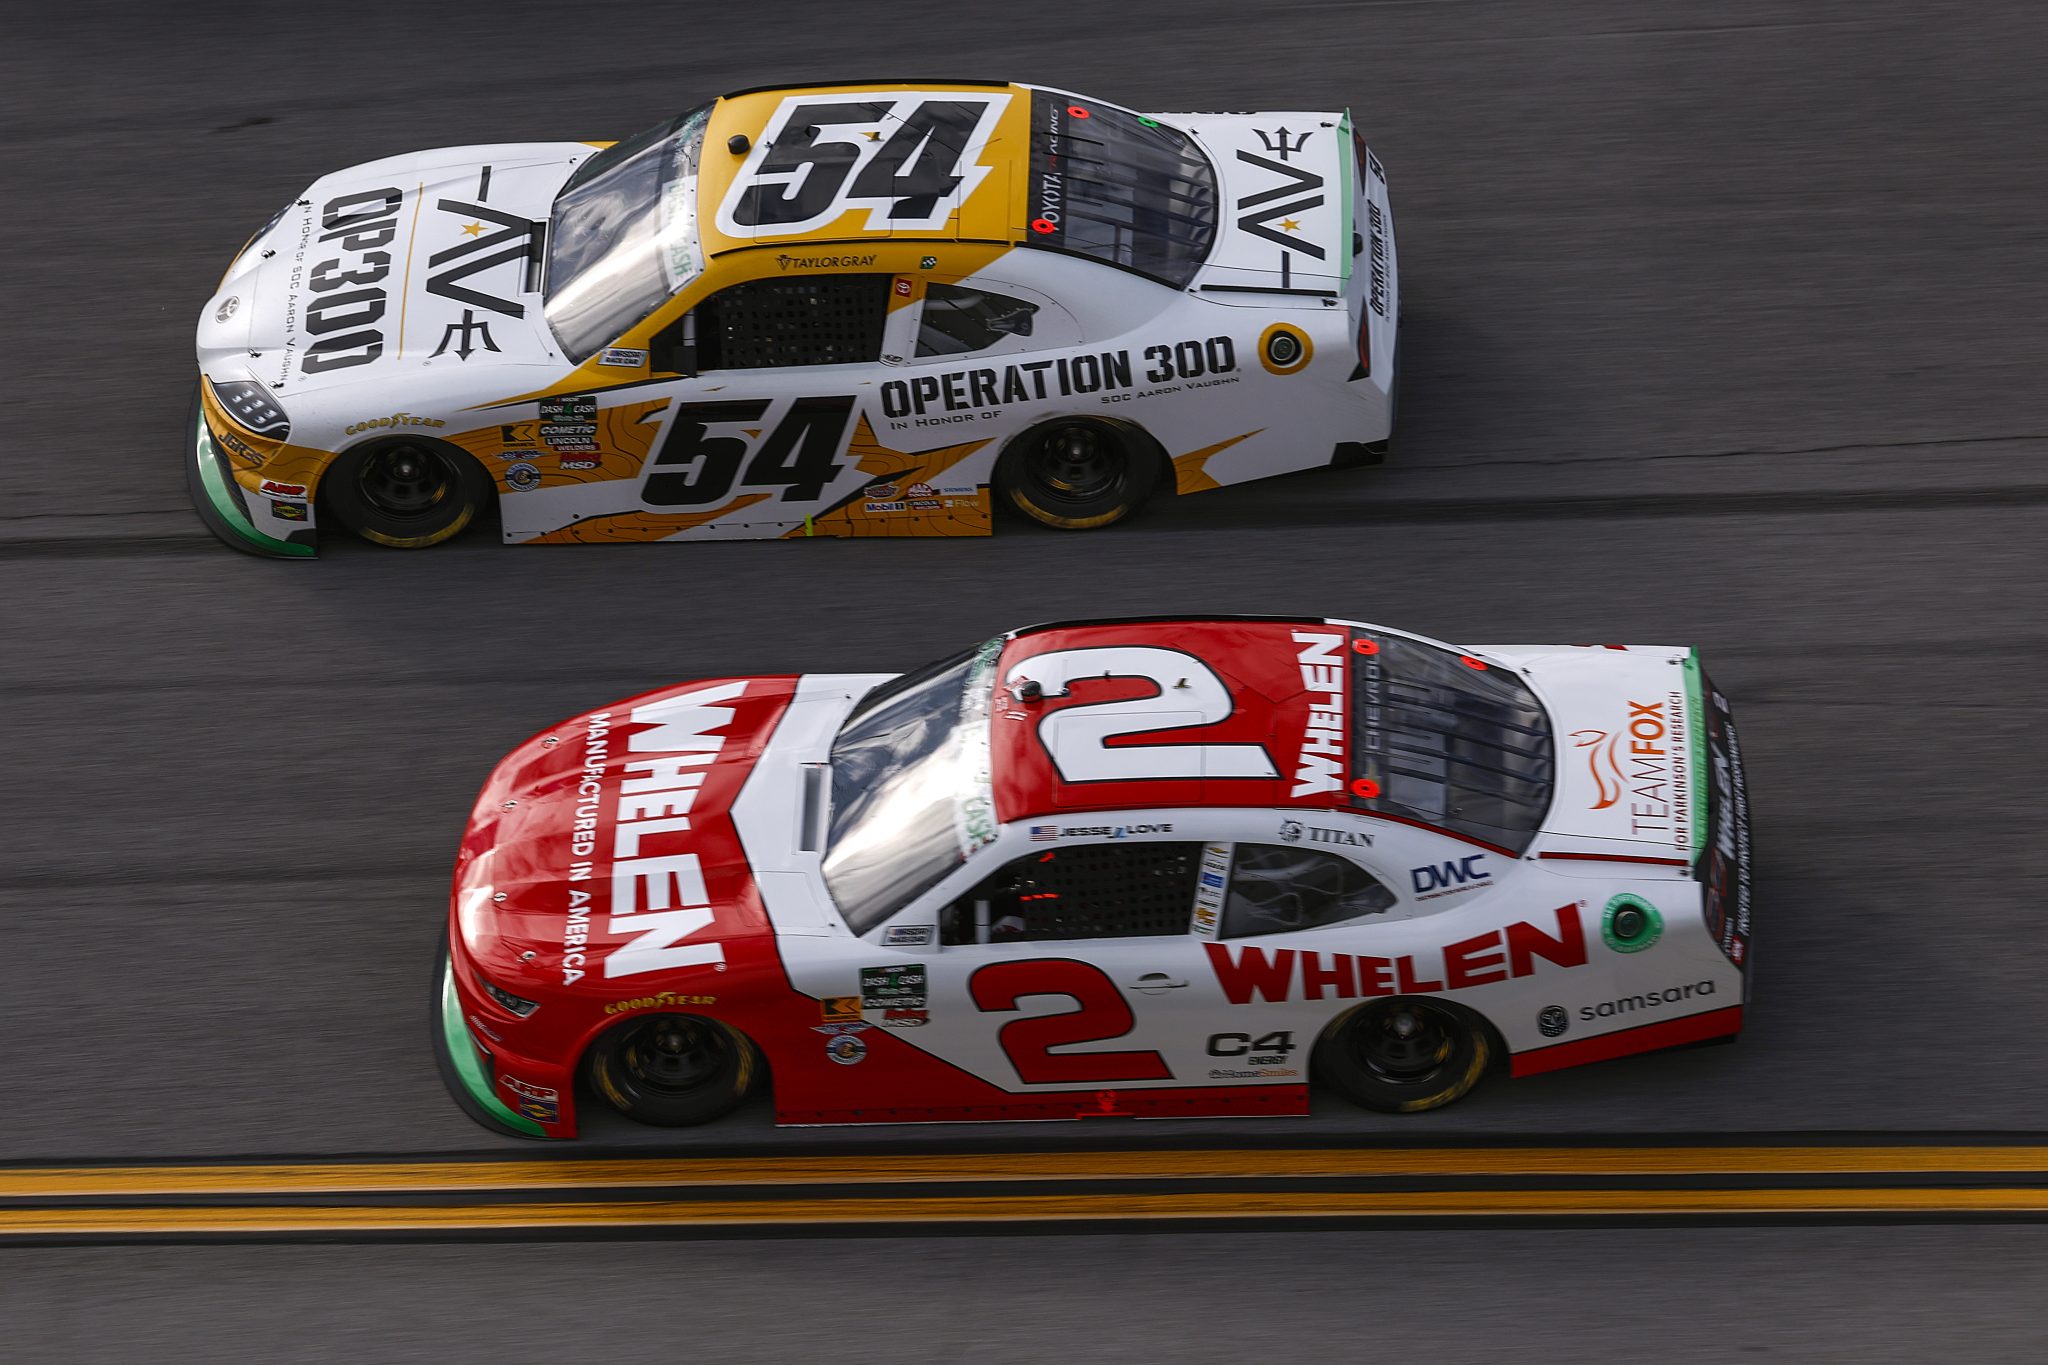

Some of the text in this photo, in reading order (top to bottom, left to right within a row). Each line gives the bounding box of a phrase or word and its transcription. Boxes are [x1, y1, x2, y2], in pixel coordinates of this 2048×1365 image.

[731, 99, 993, 228] 54
[1042, 172, 1062, 231] OYOTA
[1367, 199, 1385, 317] OPERATION 300
[301, 187, 402, 374] OP300
[285, 294, 299, 332] AARON
[280, 337, 296, 382] VAUGHN
[880, 336, 1236, 419] OPERATION 300
[1100, 377, 1240, 404] SOC AARON VAUGHN
[345, 412, 446, 436] GOODYEAR
[540, 425, 597, 435] COMETIC
[547, 437, 592, 446] LINCOLN
[890, 410, 1002, 430] IN HONOR OF
[560, 461, 597, 470] MSD
[641, 396, 858, 506] 54
[865, 503, 895, 512] Mobil
[1006, 645, 1282, 783] 2
[1291, 629, 1344, 798] WHELEN
[1669, 691, 1684, 743] RESEARCH
[562, 713, 611, 986] MANUFACTURED IN AMERICA
[604, 681, 749, 980] WHELEN
[1058, 823, 1114, 837] JESSE
[1126, 822, 1174, 835] LOVE
[1308, 826, 1376, 848] TITAN
[1674, 826, 1688, 851] FOR
[1409, 853, 1492, 894] DWC
[1203, 902, 1590, 1005] WHELEN
[604, 991, 717, 1015] GOODYEAR
[969, 958, 1176, 1084] 2
[1579, 978, 1716, 1022] samsara
[1206, 1031, 1297, 1057] C4
